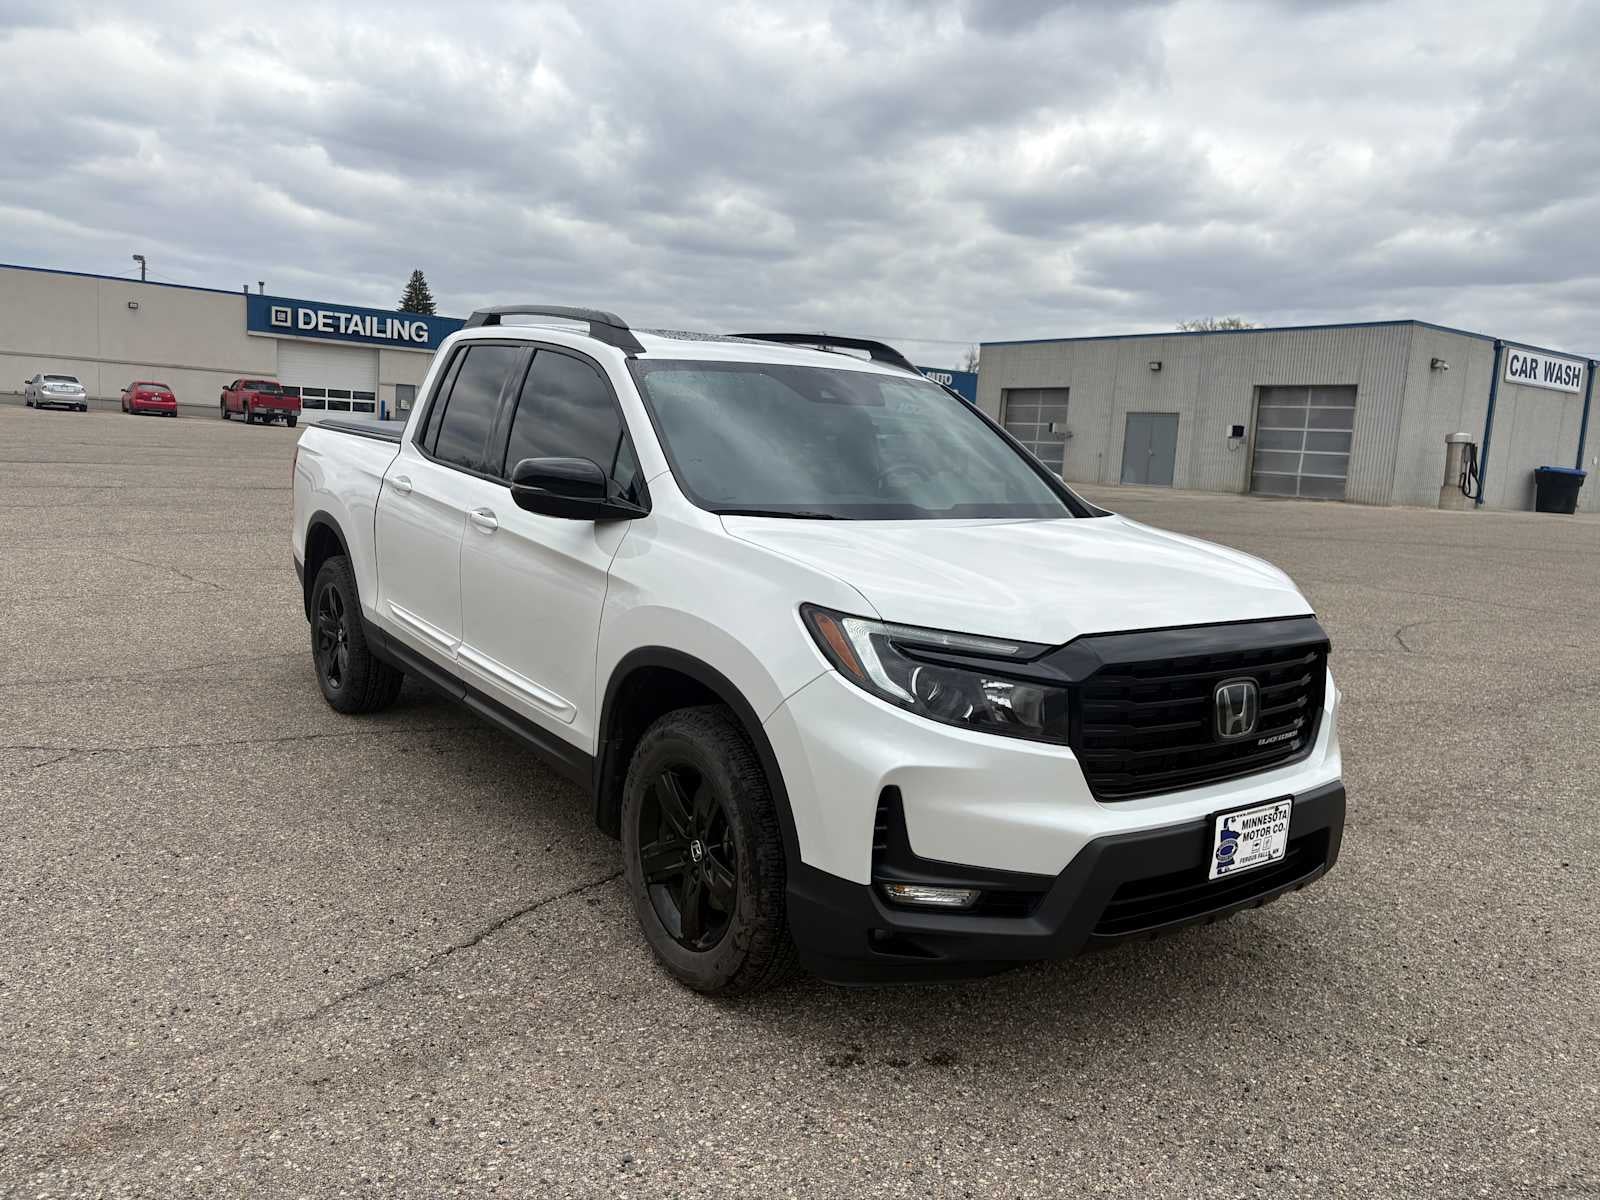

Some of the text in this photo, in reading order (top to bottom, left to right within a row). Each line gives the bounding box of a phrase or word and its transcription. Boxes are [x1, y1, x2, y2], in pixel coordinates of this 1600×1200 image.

[297, 308, 428, 343] DETAILING
[1510, 354, 1581, 387] CAR WASH
[1241, 809, 1287, 830] MINNESOTA
[1242, 822, 1286, 842] MOTOR CO.
